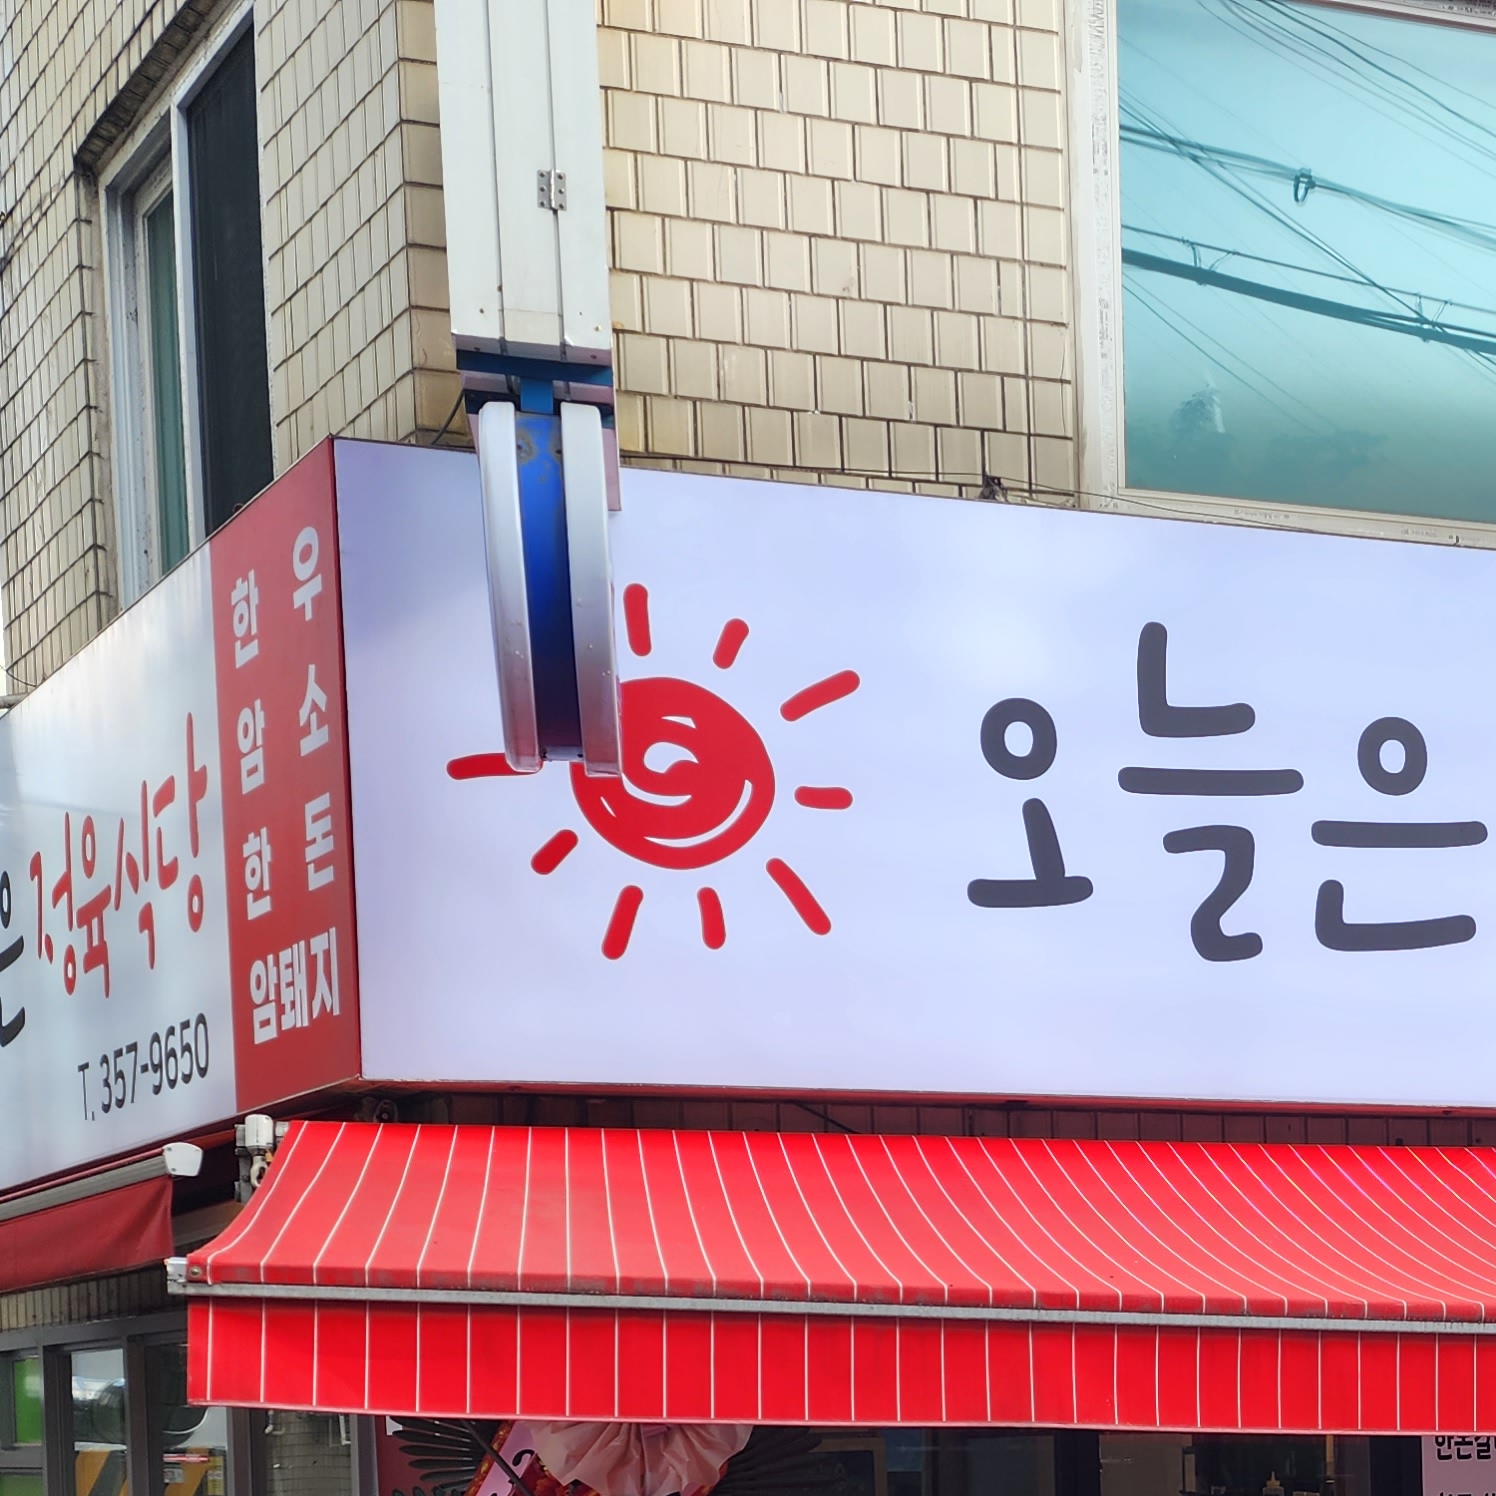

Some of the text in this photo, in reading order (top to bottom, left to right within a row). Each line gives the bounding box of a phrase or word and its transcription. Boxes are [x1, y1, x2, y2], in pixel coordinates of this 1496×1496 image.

[29, 711, 208, 999] 정육식당
[967, 621, 1488, 962] 오늘은
[99, 1012, 209, 1115] 357-9650
[249, 926, 340, 1045] 암퇘지
